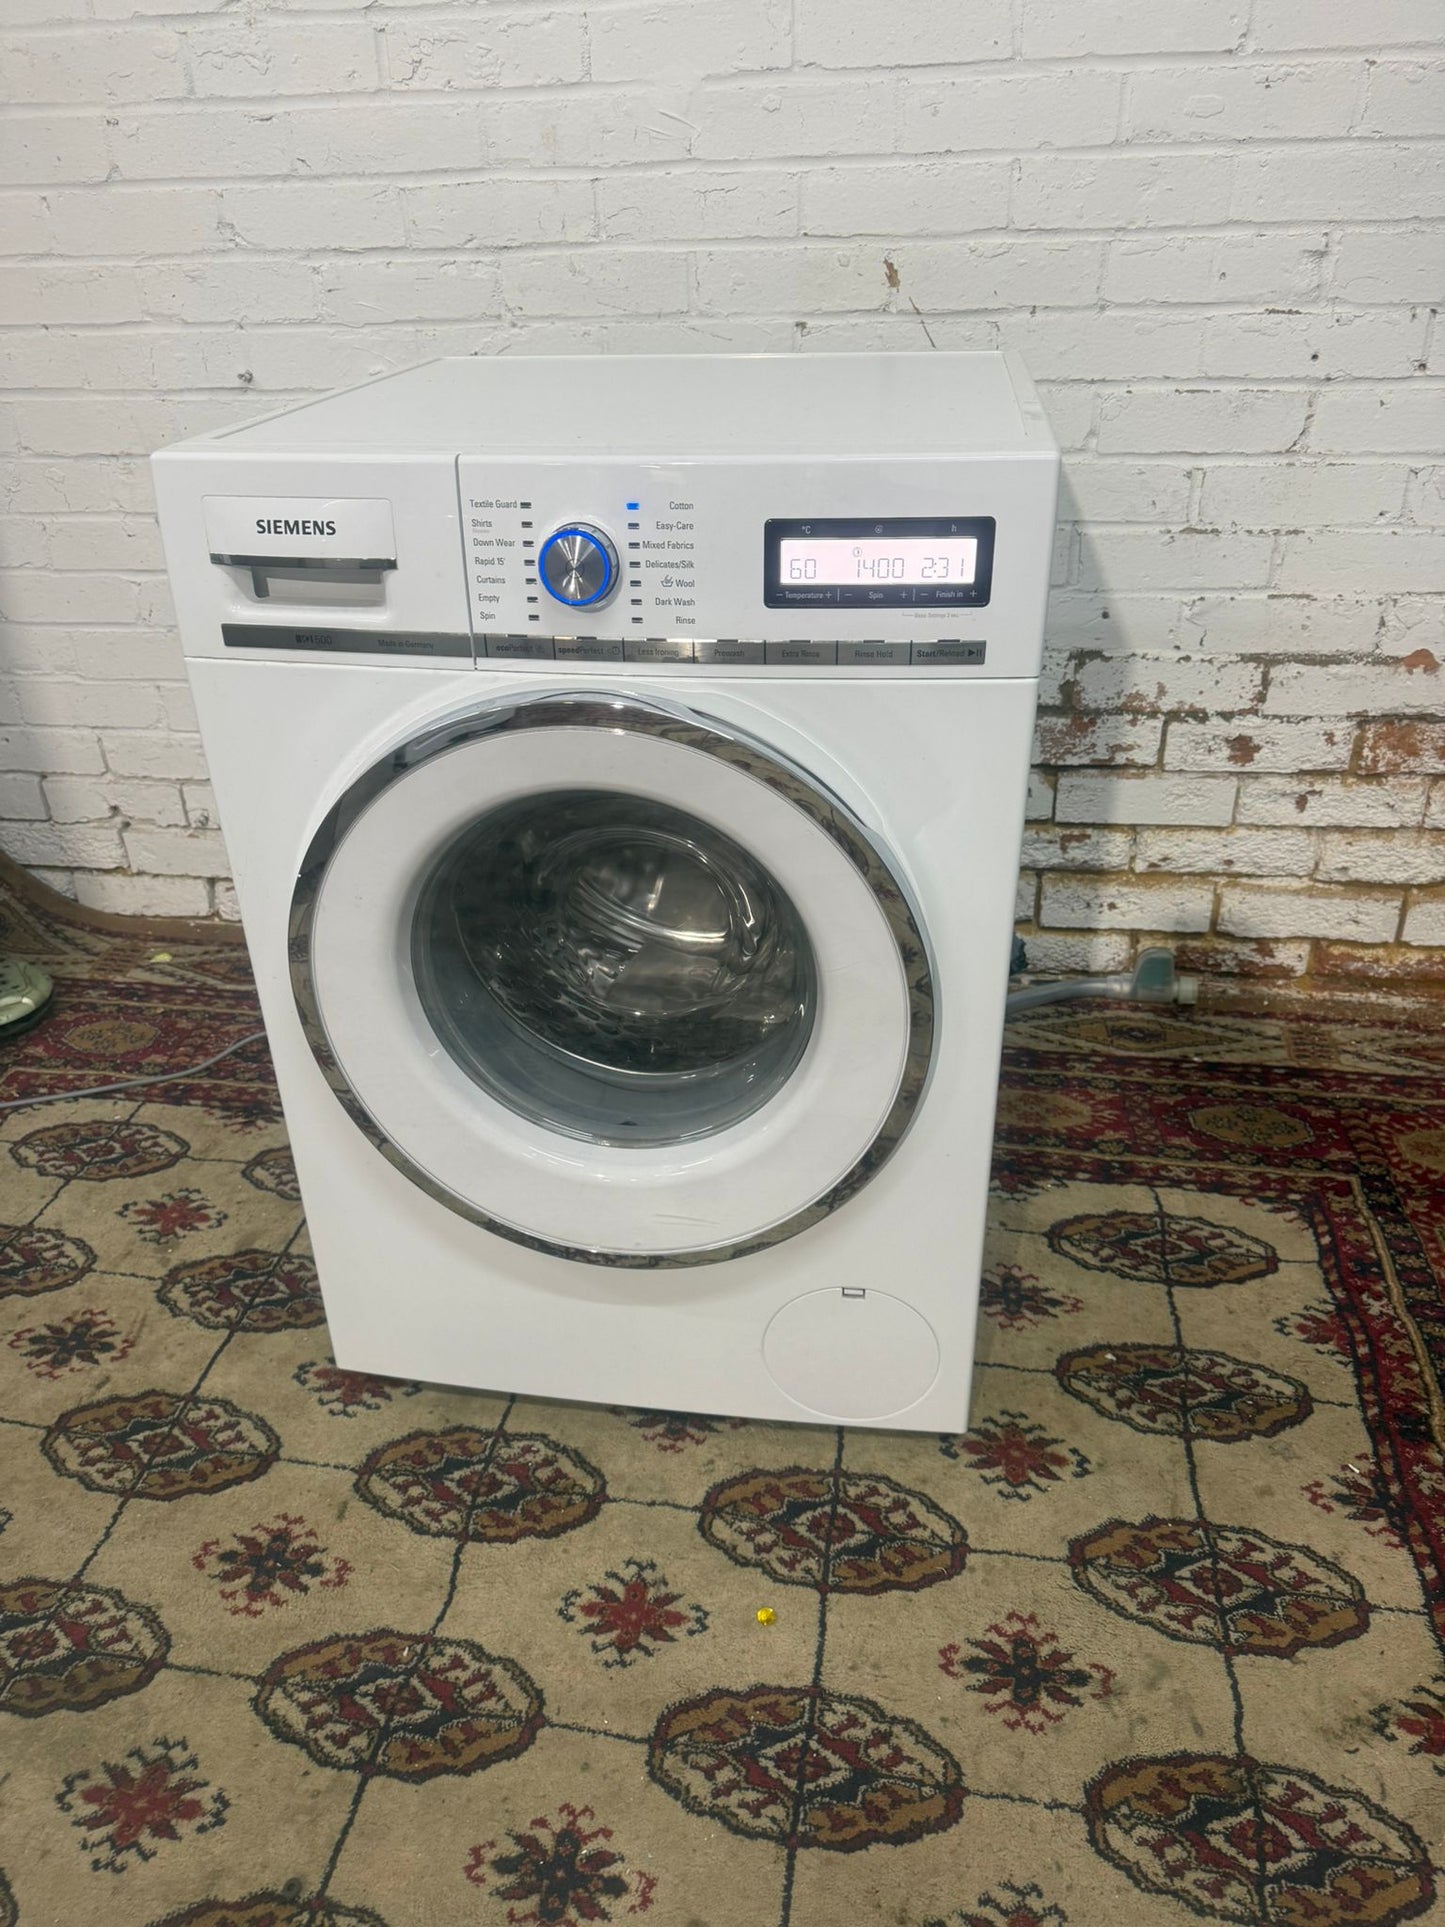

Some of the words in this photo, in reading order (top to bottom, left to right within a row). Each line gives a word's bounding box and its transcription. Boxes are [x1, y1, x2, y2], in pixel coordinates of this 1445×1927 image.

[470, 499, 494, 508] Textile
[495, 499, 518, 509] Guard
[669, 501, 694, 510] Cotton
[256, 519, 336, 536] SIEMENS
[472, 519, 492, 528] Shirts
[656, 521, 694, 531] Easy-Care
[473, 538, 494, 547] Down
[496, 538, 516, 548] Wear
[642, 541, 666, 550] Mixed
[666, 541, 694, 550] Fabrics
[475, 556, 496, 566] Rapid
[645, 560, 695, 569] Delicates/Silk
[790, 558, 816, 580] 60
[856, 558, 904, 578] 1400
[476, 575, 506, 584] Curtains
[675, 580, 696, 588] Wool
[478, 593, 500, 603] Empty
[785, 592, 824, 600] Temperature
[868, 591, 884, 601] Spin
[935, 590, 954, 598] Finish
[955, 590, 964, 598] in
[655, 597, 672, 606] Dark
[674, 598, 696, 606] Wash
[480, 611, 496, 621] Spin
[675, 616, 696, 624] Rinse
